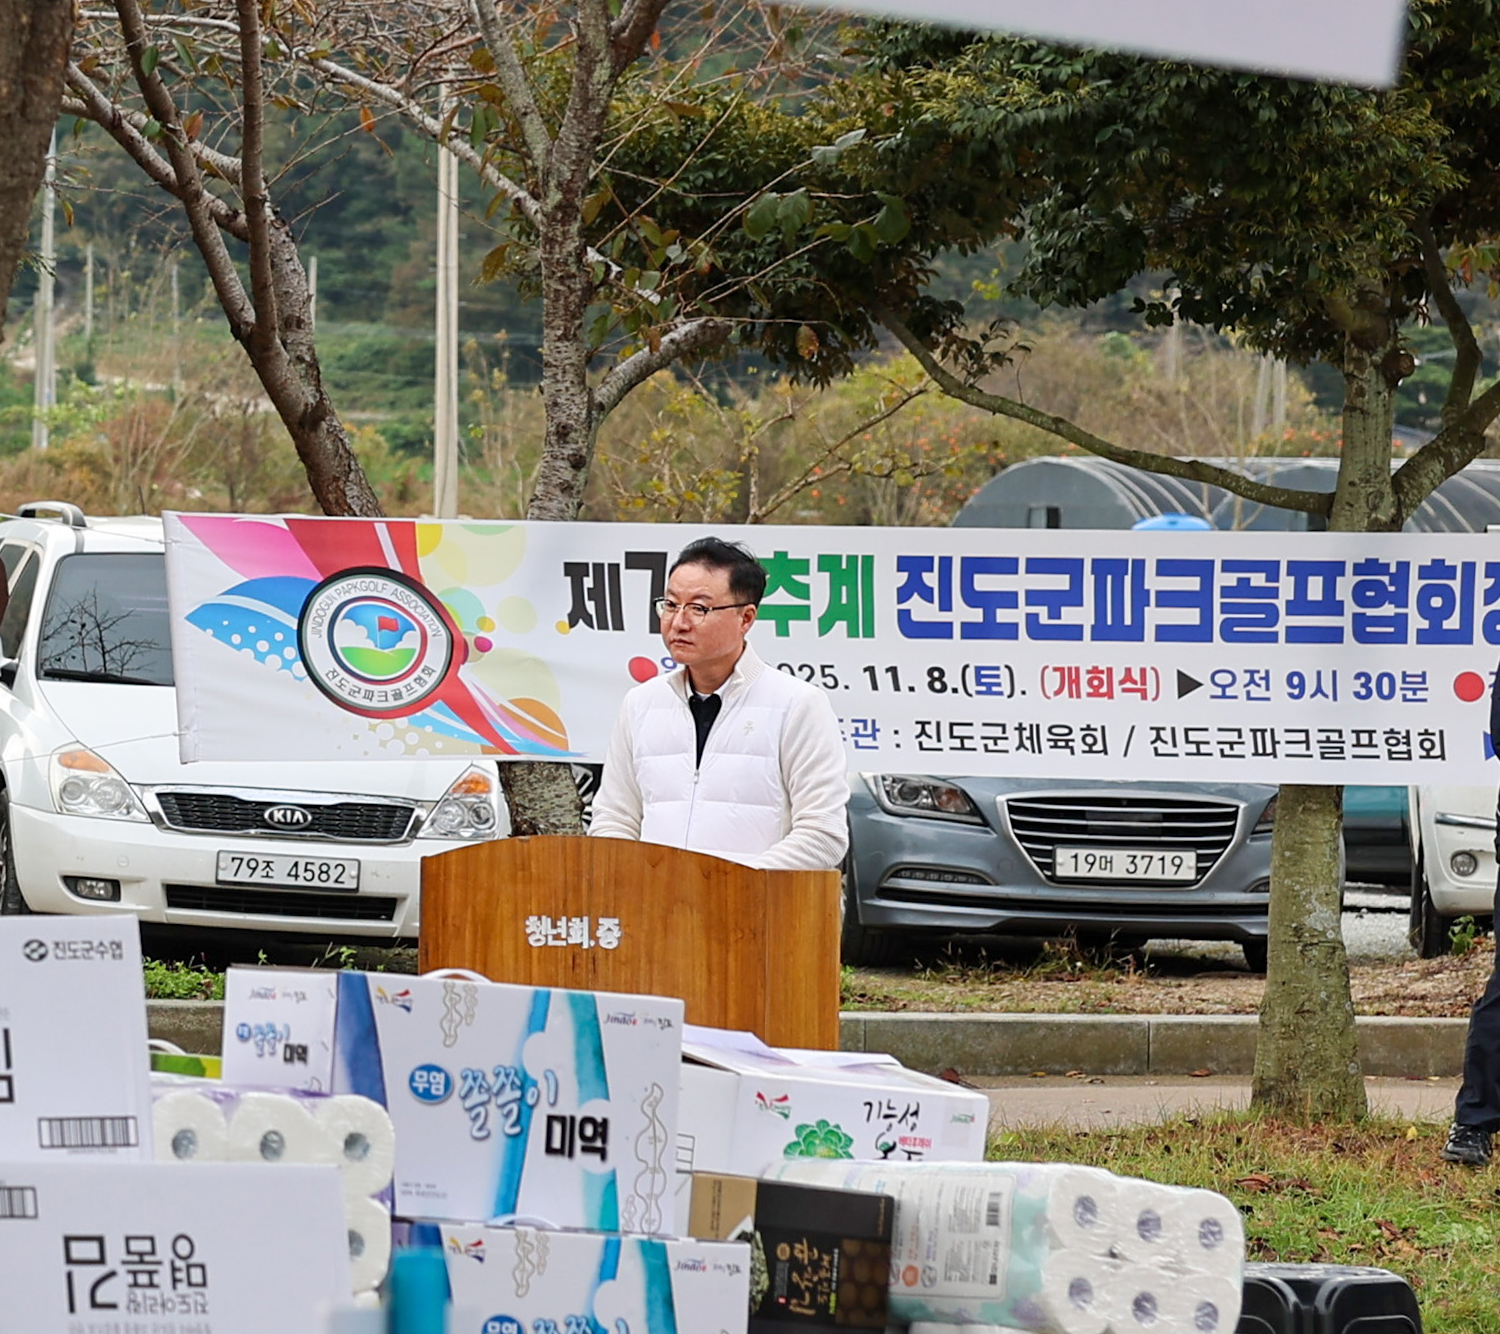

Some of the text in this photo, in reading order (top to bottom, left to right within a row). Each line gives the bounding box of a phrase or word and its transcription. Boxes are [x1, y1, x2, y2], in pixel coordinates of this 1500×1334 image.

[563, 551, 668, 634] 제7
[761, 551, 876, 639] 추계
[776, 663, 851, 690] 025.
[863, 666, 916, 693] 11.
[1040, 665, 1161, 701] (개회식)
[1209, 668, 1272, 701] 오전
[1286, 669, 1338, 703] 9시
[1353, 671, 1429, 703] 30분
[914, 722, 1108, 757] 진도군체육회
[1150, 726, 1446, 761] 진도군파크골프협회
[269, 807, 310, 825] KIA
[230, 856, 346, 886] 79조 4582
[1069, 852, 1185, 877] 19머 3719
[52, 940, 124, 961] 진도군수협
[412, 1070, 449, 1097] 무염
[863, 1097, 921, 1133] 기능성
[544, 1113, 609, 1161] 미역
